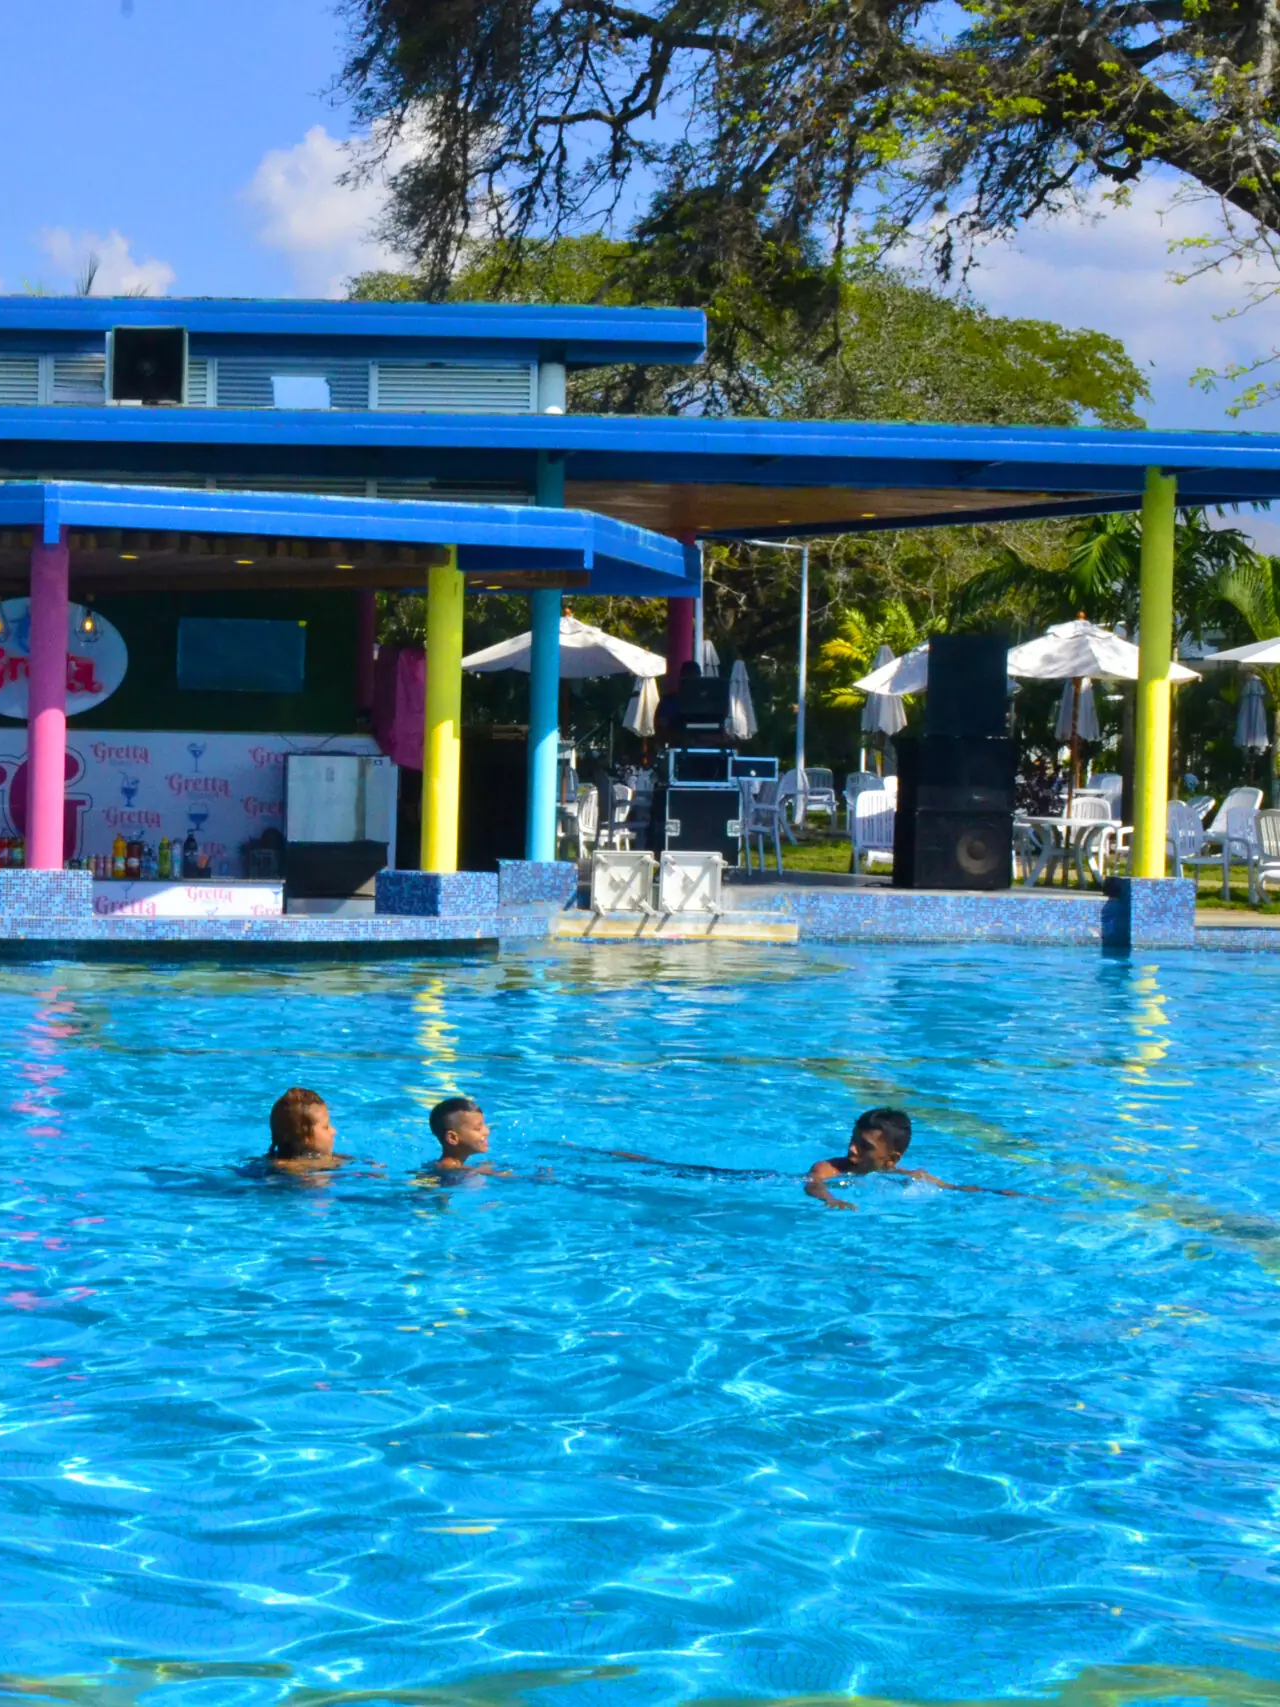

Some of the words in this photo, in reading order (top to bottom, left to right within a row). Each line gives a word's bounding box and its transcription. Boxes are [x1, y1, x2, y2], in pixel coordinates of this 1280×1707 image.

[89, 741, 150, 764] Gretta
[165, 771, 231, 797] Gretta
[102, 805, 161, 828] Gretta
[93, 895, 157, 916] Gretta
[186, 886, 233, 903] Gretta
